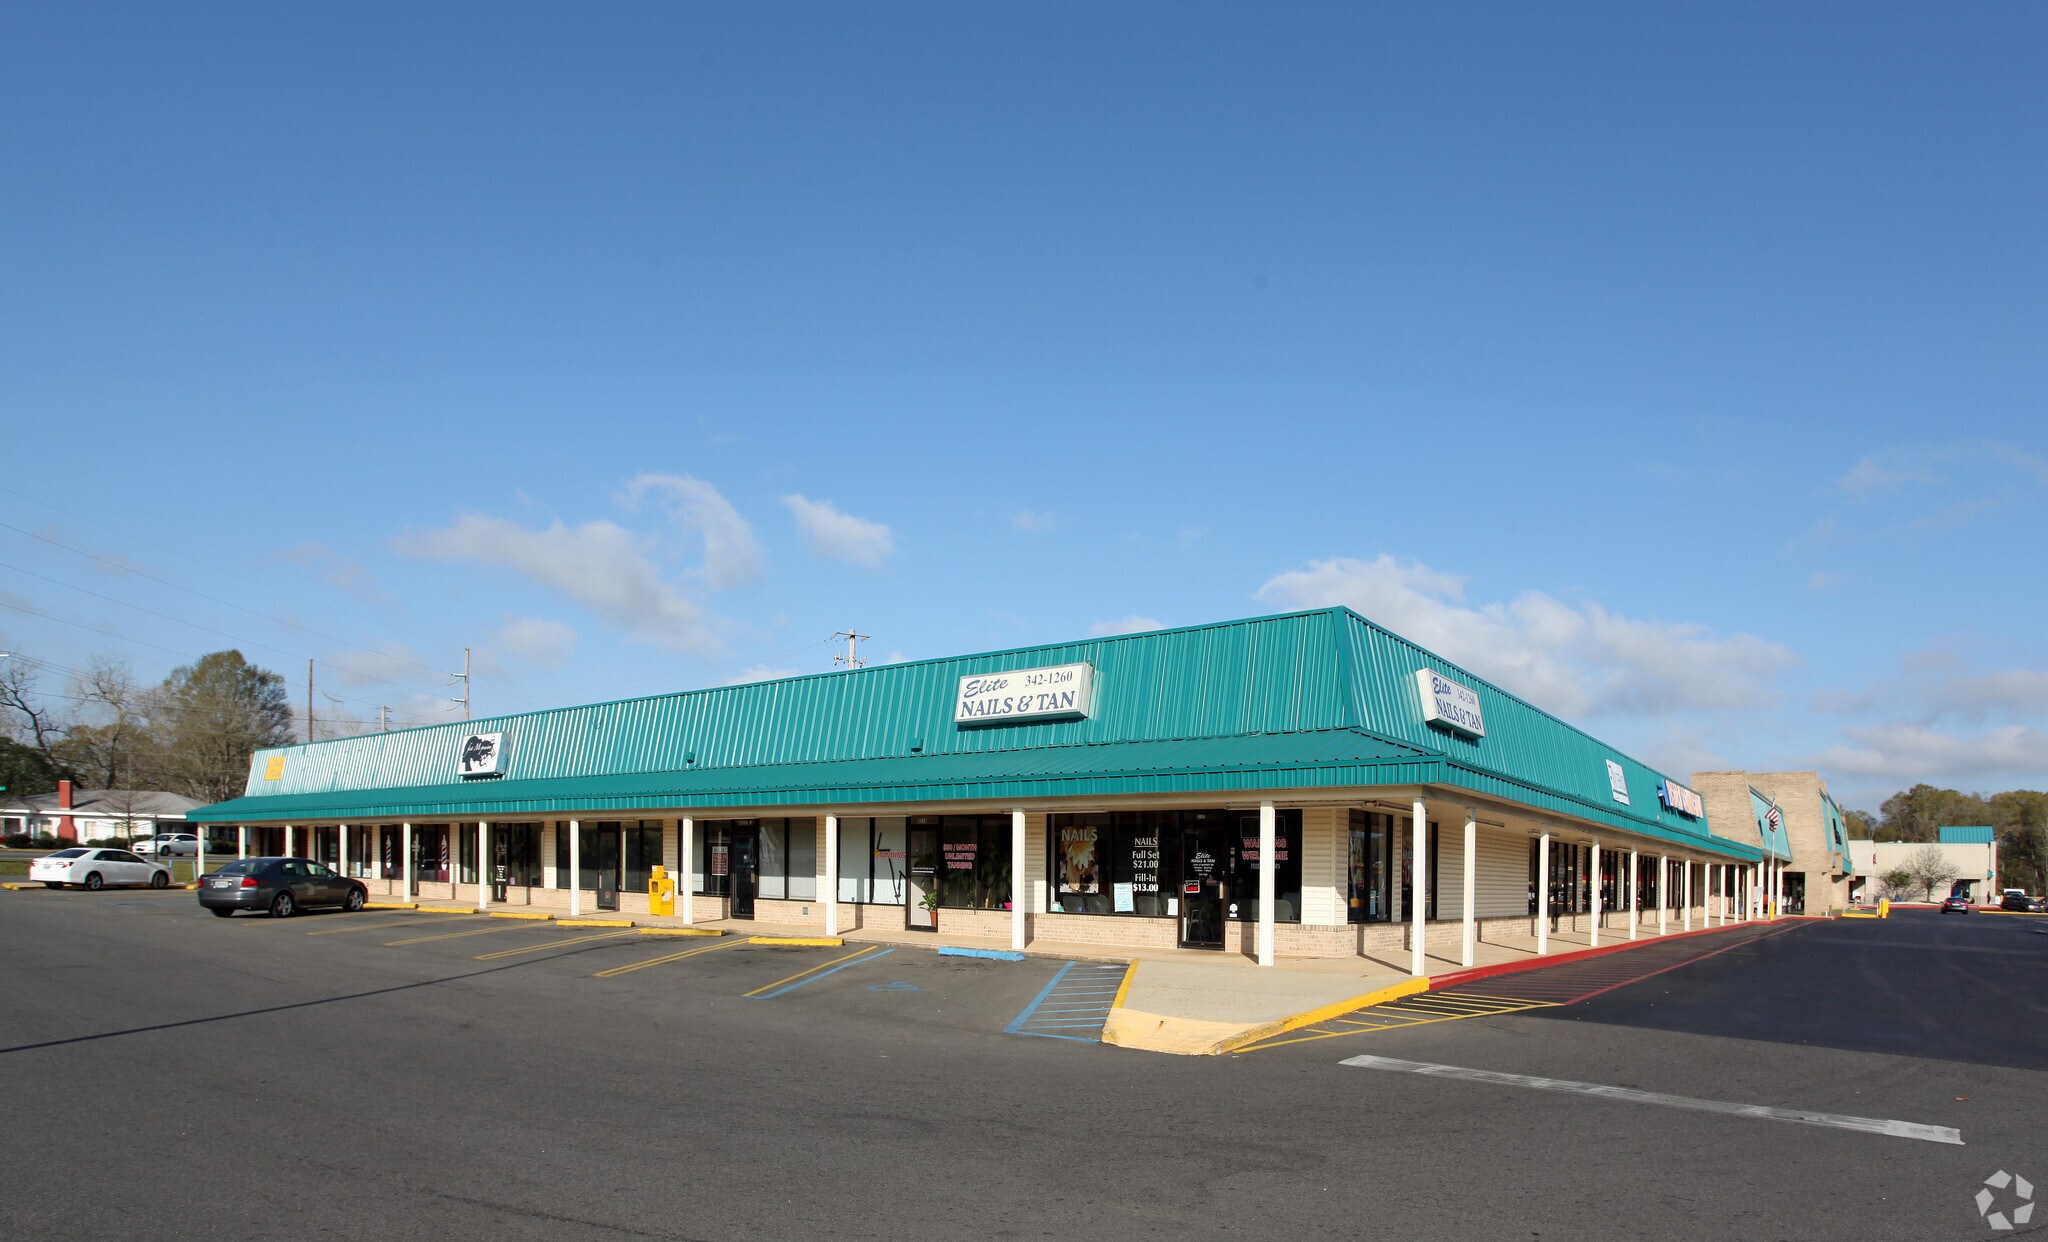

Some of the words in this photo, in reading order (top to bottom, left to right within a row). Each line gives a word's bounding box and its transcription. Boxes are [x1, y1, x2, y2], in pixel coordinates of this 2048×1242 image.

[964, 679, 1008, 698] Elite
[1025, 671, 1072, 687] 342-1260
[1433, 677, 1451, 694] Elite
[960, 697, 1013, 717] NAILS
[1017, 696, 1033, 712] &
[1037, 691, 1076, 710] TAN
[1435, 697, 1460, 723] NAILS
[1460, 708, 1466, 725] &
[1466, 711, 1482, 731] TAN
[1061, 828, 1098, 841] NAILS
[1134, 837, 1158, 847] NAILS
[1132, 850, 1146, 859] Full
[1148, 850, 1160, 859] Set
[1195, 852, 1210, 860] Elite
[1133, 860, 1159, 869] $21.00
[1134, 873, 1157, 882] Fill-In
[1133, 883, 1159, 892] $13.00
